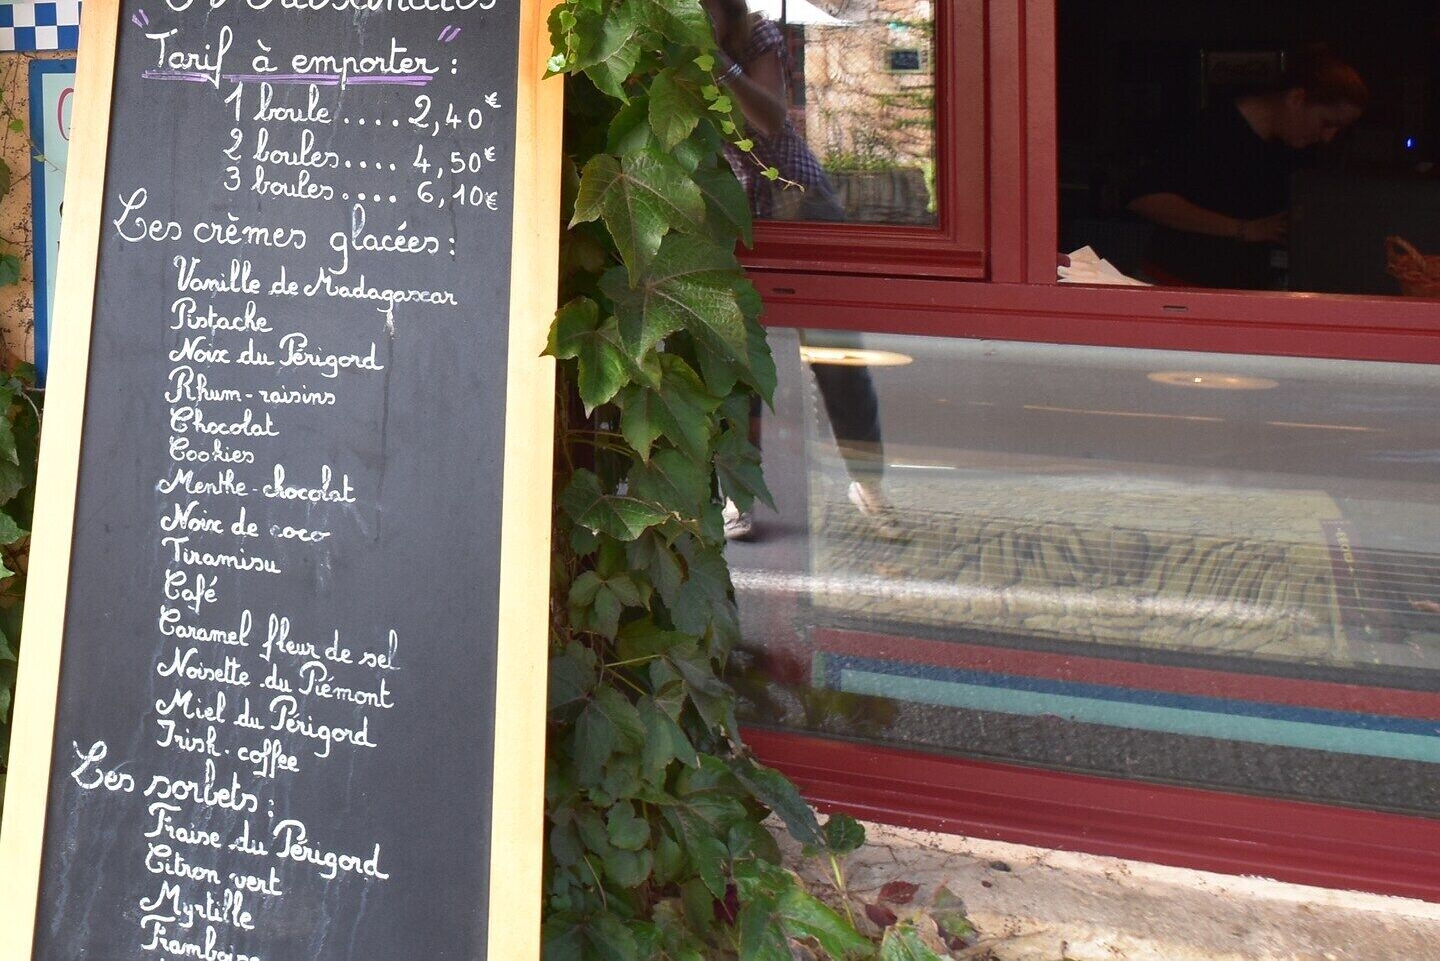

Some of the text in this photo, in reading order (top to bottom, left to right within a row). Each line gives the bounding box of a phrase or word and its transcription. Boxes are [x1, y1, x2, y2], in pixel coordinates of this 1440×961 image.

[252, 39, 278, 73] à
[291, 37, 440, 89] emporter
[224, 80, 243, 122] 1
[253, 81, 332, 124] boule
[223, 128, 243, 162] 2
[252, 127, 340, 168] boules
[223, 166, 242, 191] 3
[250, 165, 334, 200] boules
[113, 187, 182, 243] Les
[193, 212, 307, 248] crèmes
[329, 202, 440, 275] glacées
[173, 255, 458, 313] Vanille de Madagascar
[170, 297, 274, 333] Pistache
[169, 333, 385, 378] Noix du Périgord
[170, 406, 280, 437] Chocolat
[169, 435, 255, 464] Cookies
[160, 501, 331, 542] Noix de coco
[161, 536, 281, 574] Tiramisu
[164, 569, 218, 615] Café
[159, 605, 400, 670] Caramel fleur de sel
[156, 647, 394, 709] Noisette du Piémont
[156, 689, 377, 758] Miel du Périgord
[71, 740, 135, 790] Les
[143, 758, 259, 813] sorbets
[237, 738, 300, 779] coffee
[144, 801, 389, 880] Fraise du Périgord
[145, 841, 283, 897] Citron vert
[139, 880, 255, 931] Myrtille
